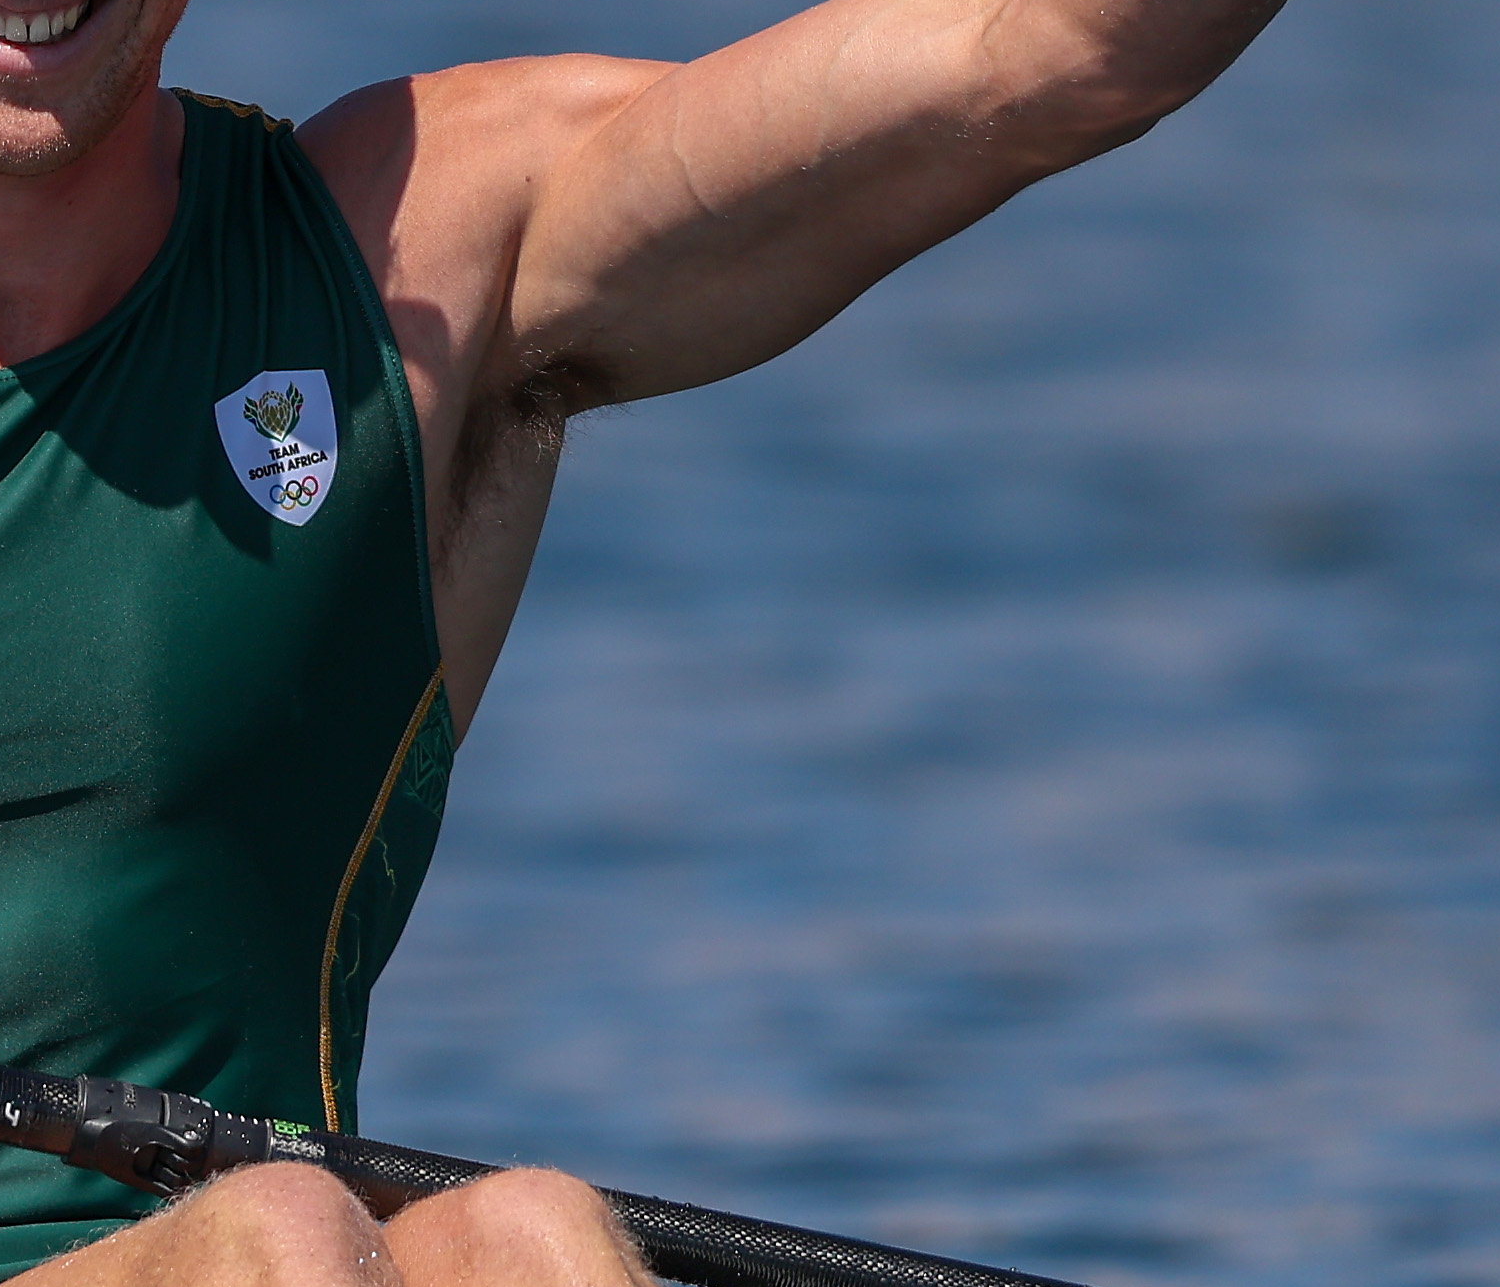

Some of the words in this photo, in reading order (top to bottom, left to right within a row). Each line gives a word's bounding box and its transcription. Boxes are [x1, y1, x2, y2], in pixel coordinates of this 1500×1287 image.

[269, 443, 300, 461] TEAM
[249, 462, 285, 481] SOUTH
[288, 450, 328, 472] AFRICA
